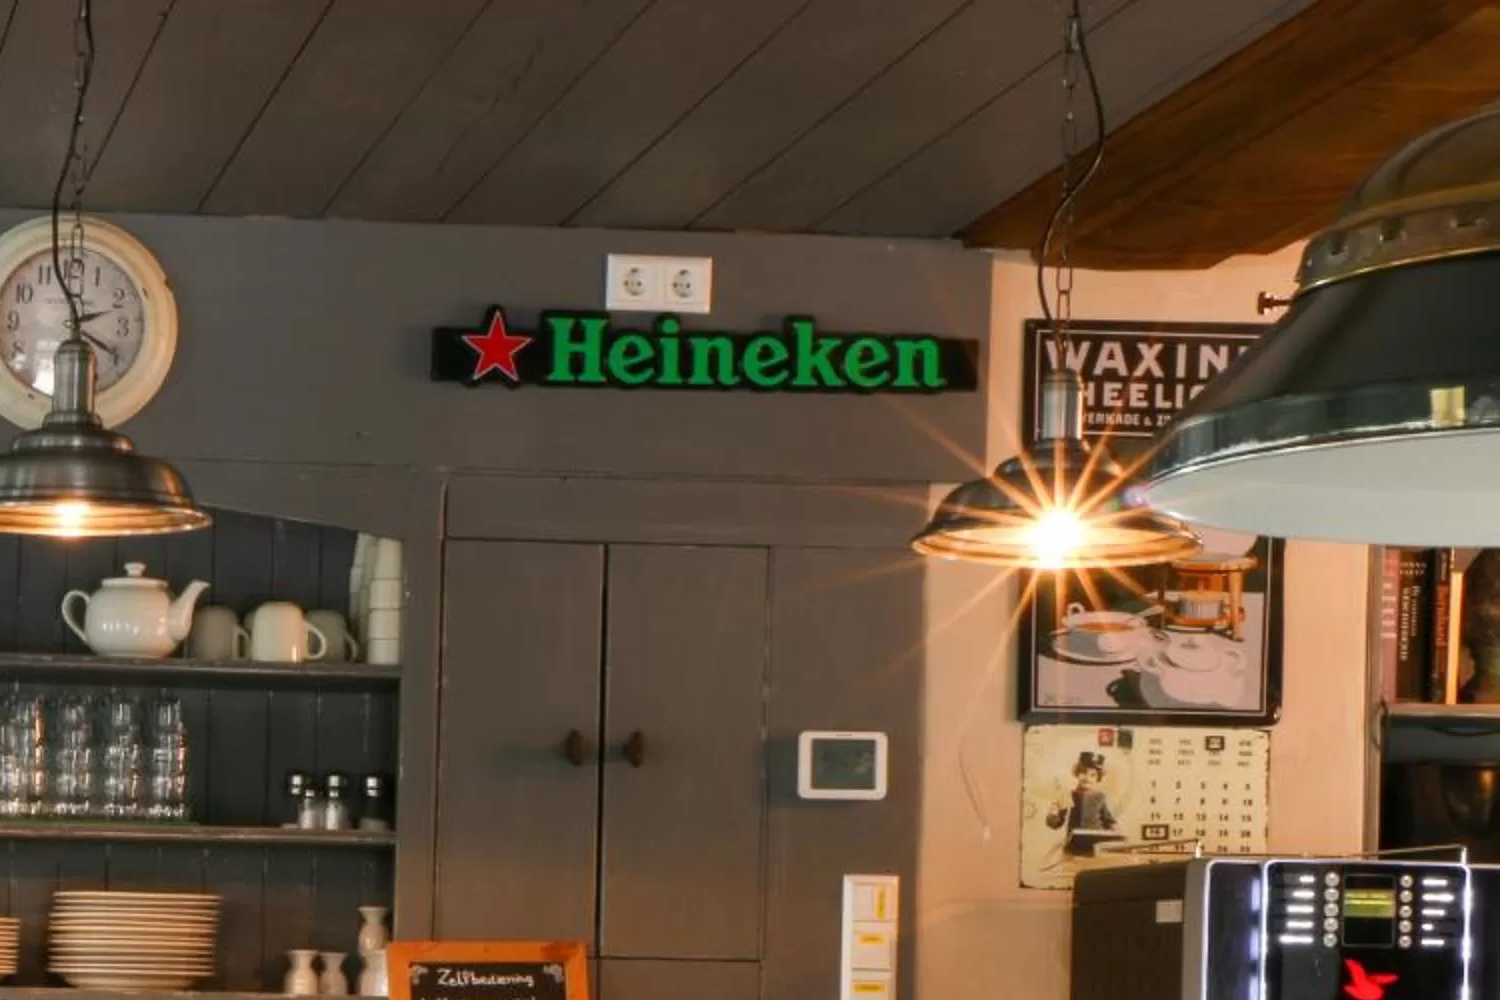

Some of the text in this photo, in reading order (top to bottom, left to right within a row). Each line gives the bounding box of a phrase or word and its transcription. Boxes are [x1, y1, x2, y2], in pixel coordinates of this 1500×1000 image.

[38, 264, 52, 285] 11
[15, 283, 33, 304] 10
[112, 288, 125, 309] 2
[6, 311, 20, 331] 9
[116, 316, 130, 337] 3
[547, 316, 947, 389] Heineken
[1045, 340, 1249, 379] WAXIN
[1083, 412, 1141, 426] ERKADE
